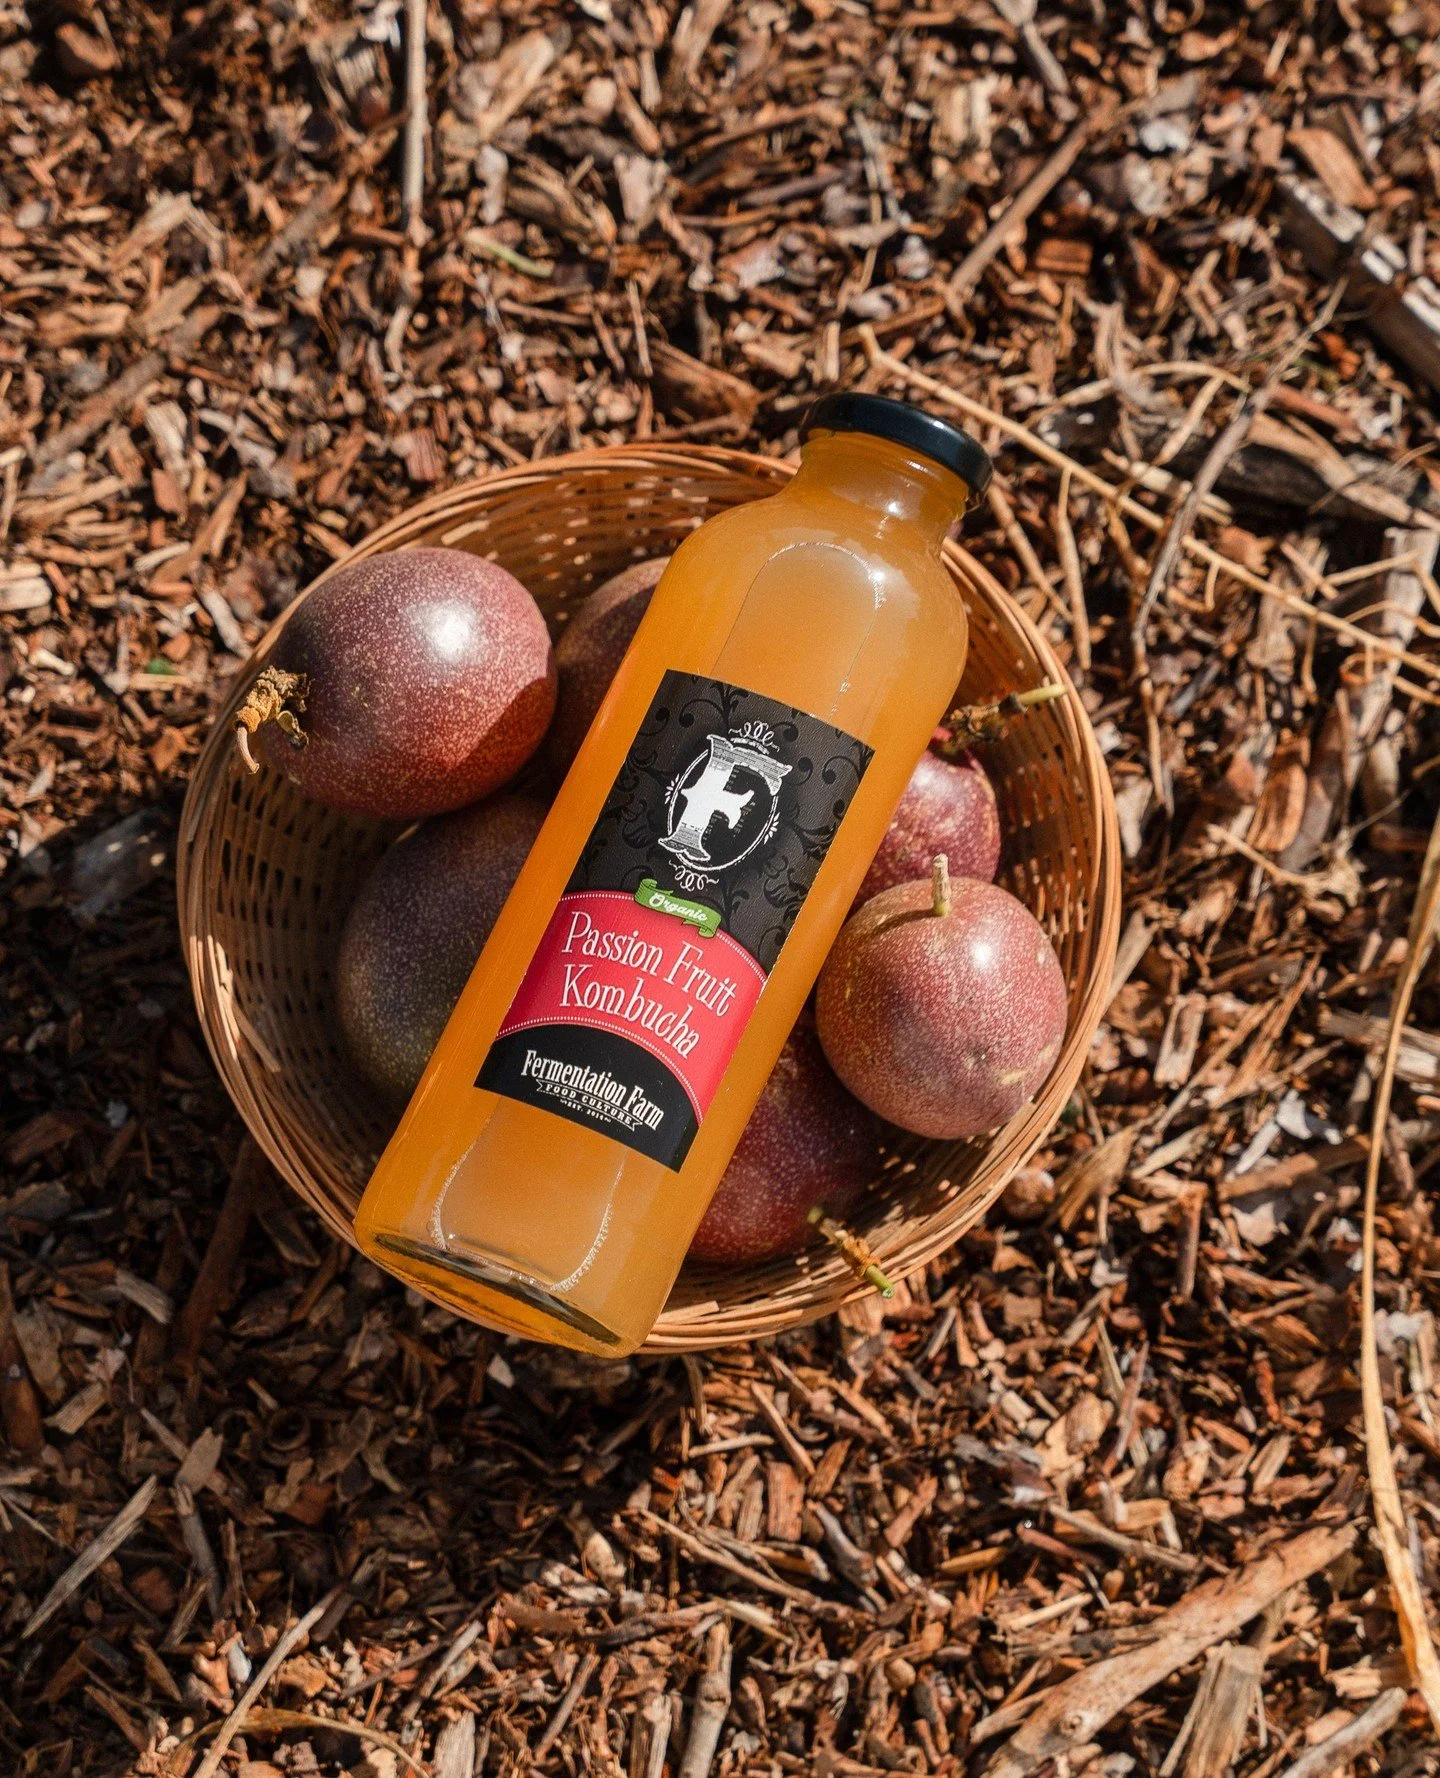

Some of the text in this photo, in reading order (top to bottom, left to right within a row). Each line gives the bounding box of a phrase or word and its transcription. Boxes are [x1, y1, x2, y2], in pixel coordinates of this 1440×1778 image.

[649, 892, 708, 922] Organic
[562, 911, 737, 1017] Passion Fruit
[560, 964, 701, 1059] Kombucha
[521, 1050, 664, 1131] Fermentation Farm
[545, 1084, 632, 1124] FOOD CULTURE
